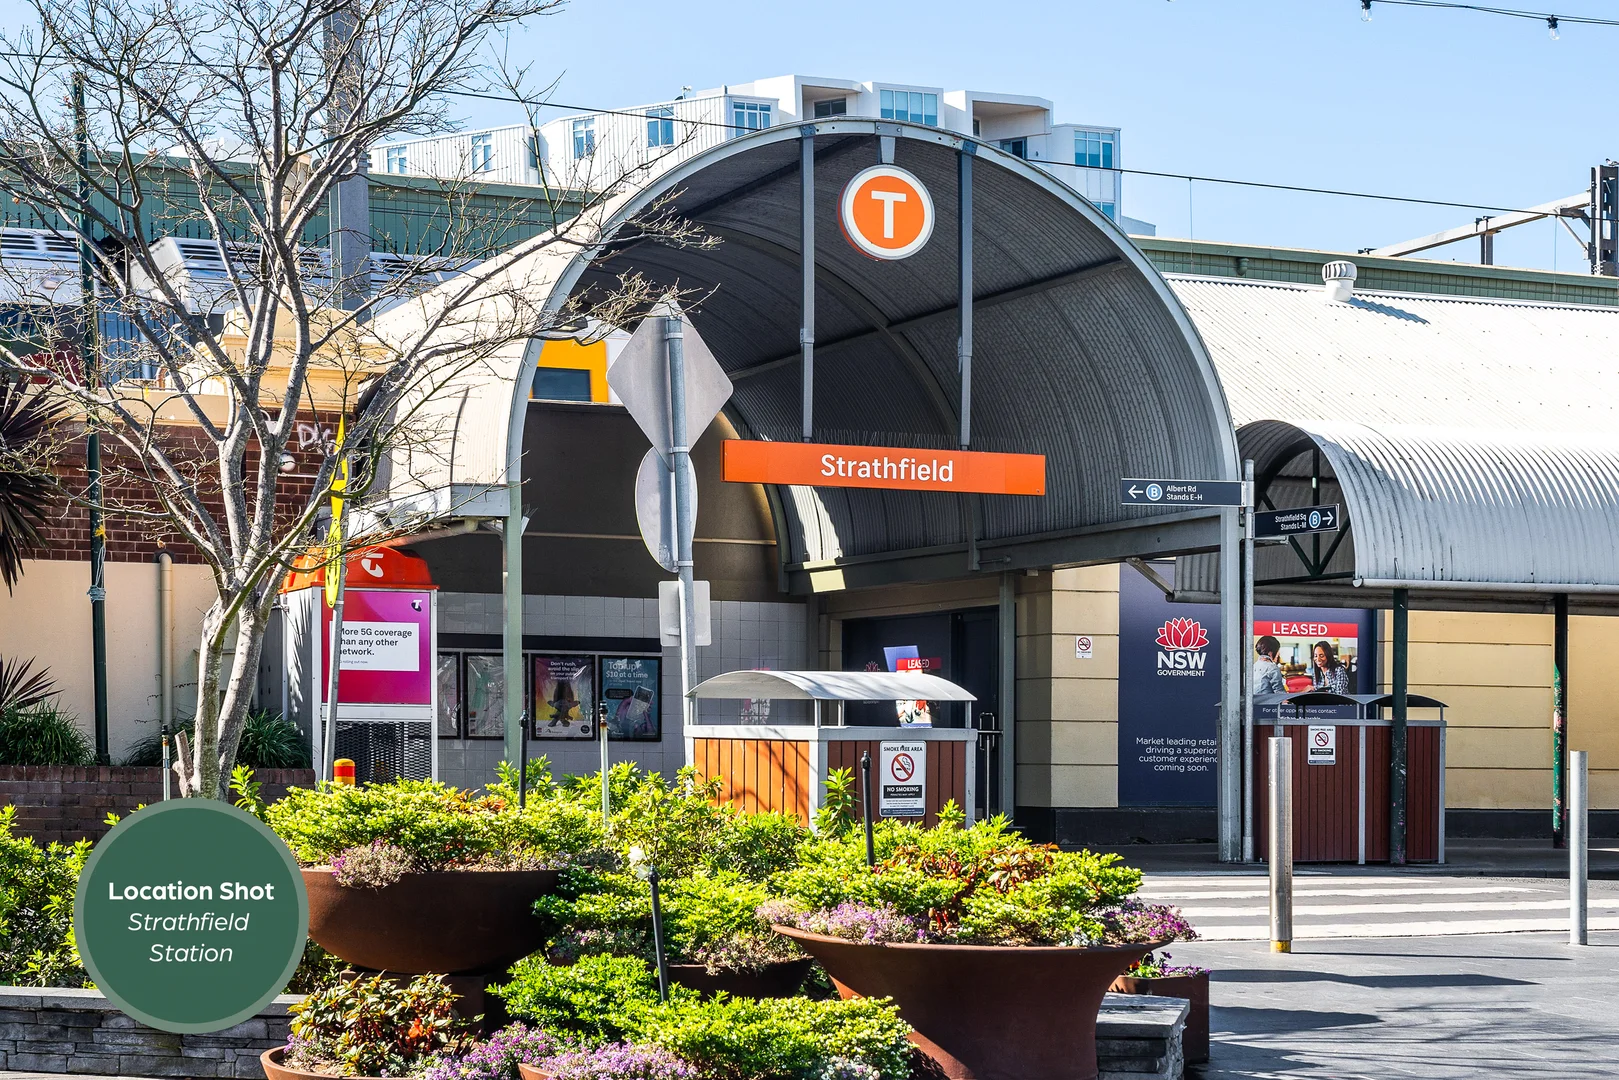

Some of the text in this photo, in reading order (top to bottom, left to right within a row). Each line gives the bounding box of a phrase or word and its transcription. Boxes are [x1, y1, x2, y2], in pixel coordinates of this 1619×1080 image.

[870, 190, 908, 239] T
[820, 453, 954, 483] Strathfield
[1166, 485, 1187, 493] Albert
[1187, 485, 1197, 493] Rd
[1166, 493, 1190, 501] Stands
[1274, 514, 1300, 524] Strathfield
[1300, 513, 1307, 523] Sq
[1280, 523, 1297, 531] Stands
[360, 628, 373, 636] 5G
[374, 629, 412, 638] coverage
[1272, 623, 1328, 636] LEASED
[358, 639, 374, 647] any
[375, 638, 398, 646] other
[907, 659, 930, 669] LEASED
[1157, 651, 1207, 669] NSW
[606, 670, 619, 678] $10
[1157, 669, 1206, 677] GOVERNMENT
[1136, 737, 1217, 747] Market leading retai
[1145, 746, 1175, 755] driving
[1184, 747, 1218, 756] superior
[1180, 756, 1218, 765] experienc
[1154, 764, 1209, 772] coming soon.
